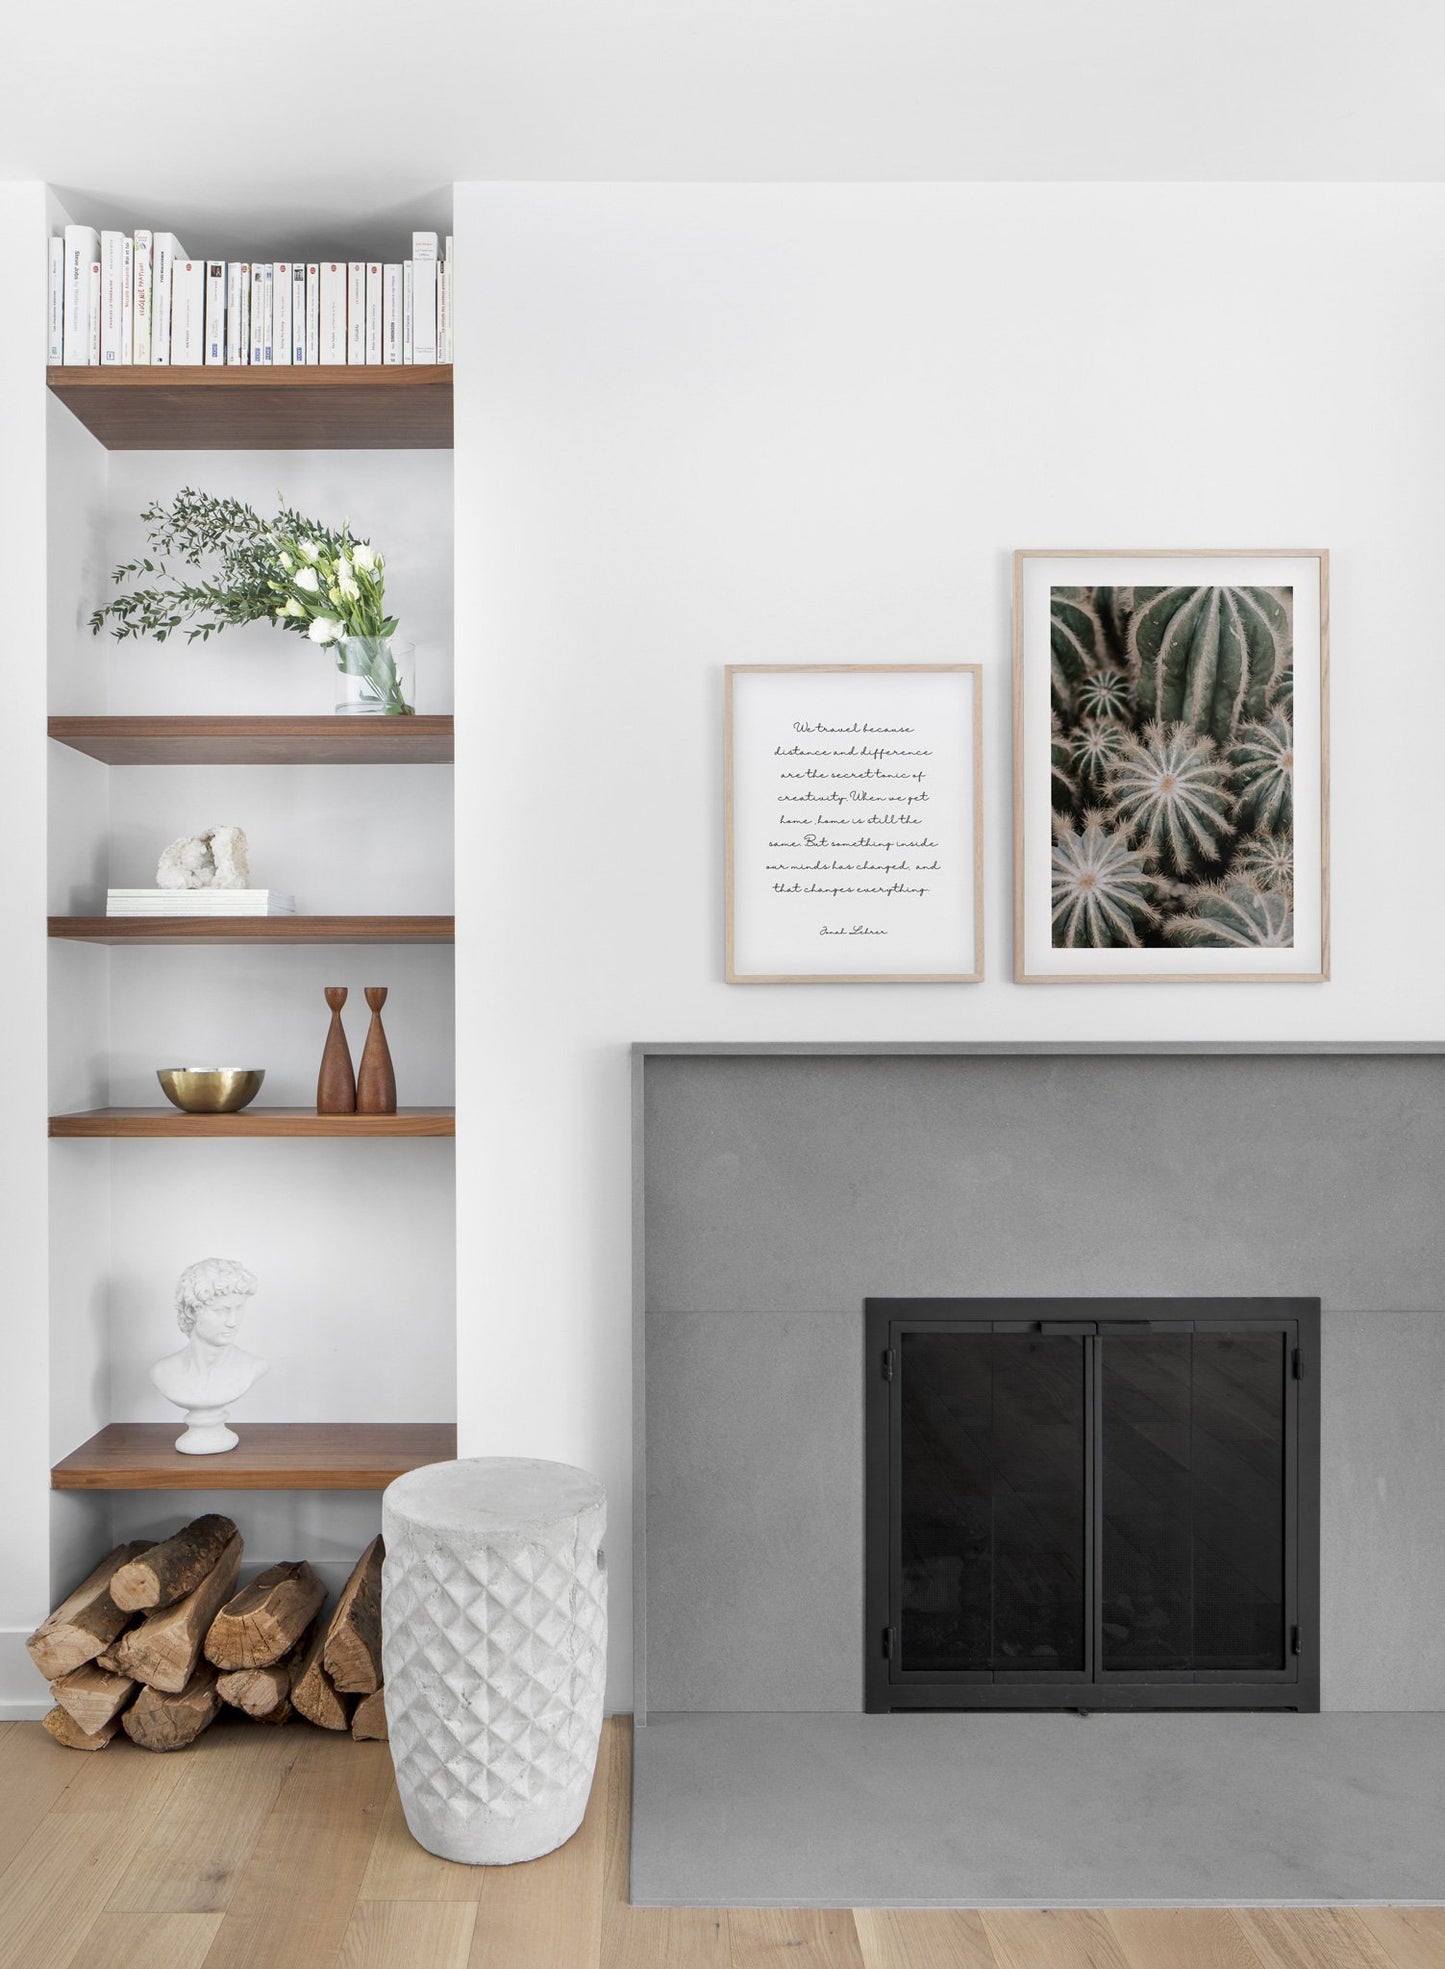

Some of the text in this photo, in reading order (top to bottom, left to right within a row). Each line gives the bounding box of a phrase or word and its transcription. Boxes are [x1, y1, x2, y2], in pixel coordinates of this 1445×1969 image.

[792, 721, 915, 734] We travel because
[773, 745, 934, 760] distance and difference
[804, 768, 830, 779] the
[830, 768, 874, 779] secret
[873, 768, 911, 779] tonic
[911, 770, 927, 783] of
[849, 789, 887, 802] When
[907, 791, 931, 806] get
[866, 813, 899, 825] still
[897, 813, 923, 825] the
[802, 833, 830, 848] But
[830, 836, 895, 852] something
[895, 837, 940, 848] inside
[790, 859, 832, 871] minds
[831, 860, 855, 870] has
[915, 859, 942, 871] and
[771, 882, 803, 894] that
[802, 882, 856, 897] changes
[819, 924, 889, 936] Jonah Lehrer
